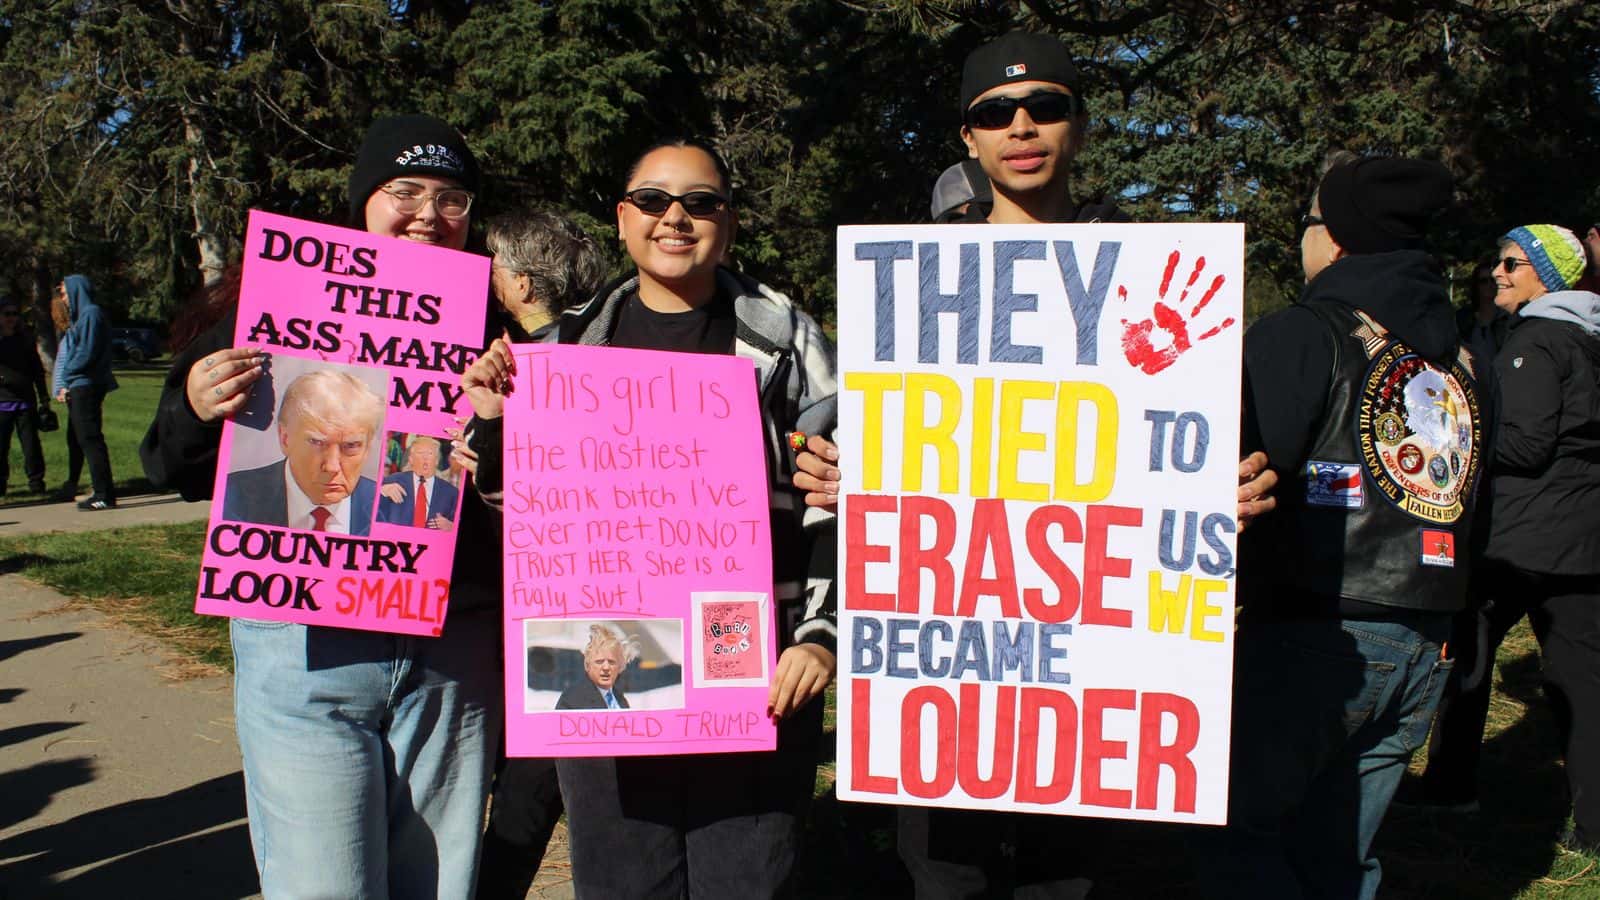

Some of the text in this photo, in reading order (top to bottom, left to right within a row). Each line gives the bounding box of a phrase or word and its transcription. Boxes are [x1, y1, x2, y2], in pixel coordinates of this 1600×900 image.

[258, 228, 377, 278] DOES
[325, 280, 442, 325] THIS
[854, 240, 1122, 366] THEY
[247, 312, 342, 353] ASS
[389, 376, 464, 415] MY
[515, 351, 731, 436] This girl is
[1365, 352, 1393, 396] FORGETS
[508, 431, 709, 473] the nastiest
[844, 372, 1119, 503] TRIED
[1144, 409, 1210, 474] TO
[1360, 431, 1384, 478] NATION
[614, 481, 676, 509] bitch
[691, 477, 747, 507] I've
[1377, 474, 1399, 500] THE
[1382, 450, 1431, 498] DEFENDERS
[508, 518, 575, 548] ever
[697, 519, 761, 550] NOT
[1410, 501, 1442, 519] FALLEN
[209, 524, 428, 574] COUNTRY
[508, 551, 577, 580] TRUST
[644, 551, 687, 577] She
[694, 555, 712, 575] is
[724, 555, 745, 573] a
[845, 494, 1143, 628] ERASE
[1157, 509, 1236, 579] US,
[200, 566, 450, 638] LOOK SMALL?
[1148, 570, 1229, 642] WE
[850, 616, 1073, 684] BECAME
[559, 711, 760, 738] DONALD TRUMP
[850, 678, 1201, 814] LOUDER
